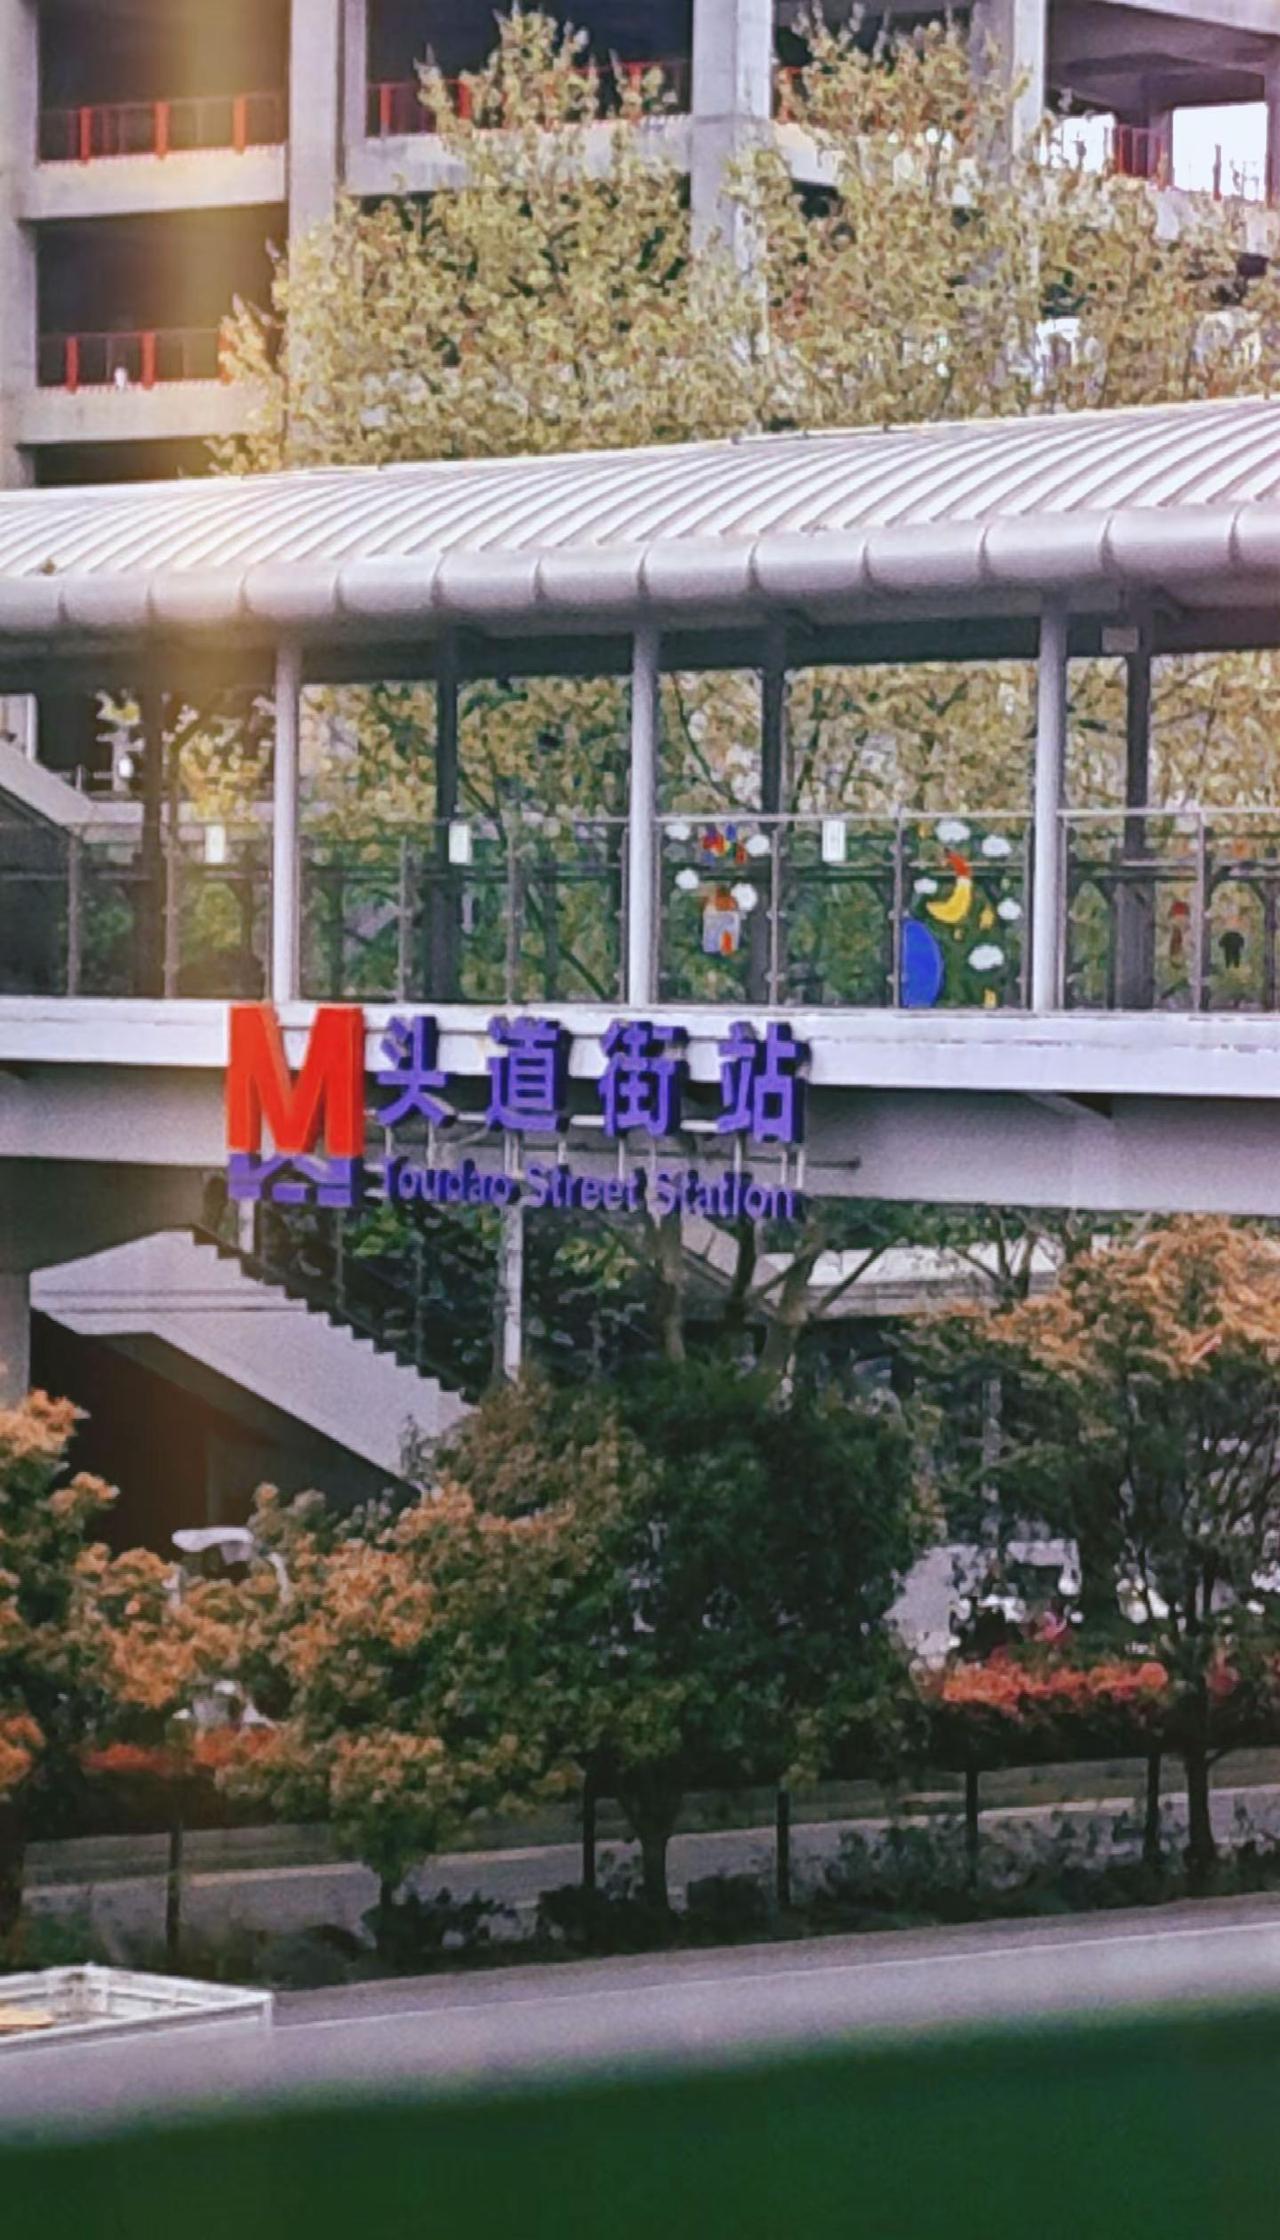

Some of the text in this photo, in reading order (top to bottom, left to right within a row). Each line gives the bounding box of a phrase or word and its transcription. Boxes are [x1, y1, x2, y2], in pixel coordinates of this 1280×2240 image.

[227, 1005, 364, 1155] M
[376, 1015, 798, 1143] 头道街站
[527, 1161, 639, 1212] Street
[653, 1166, 794, 1220] Station
